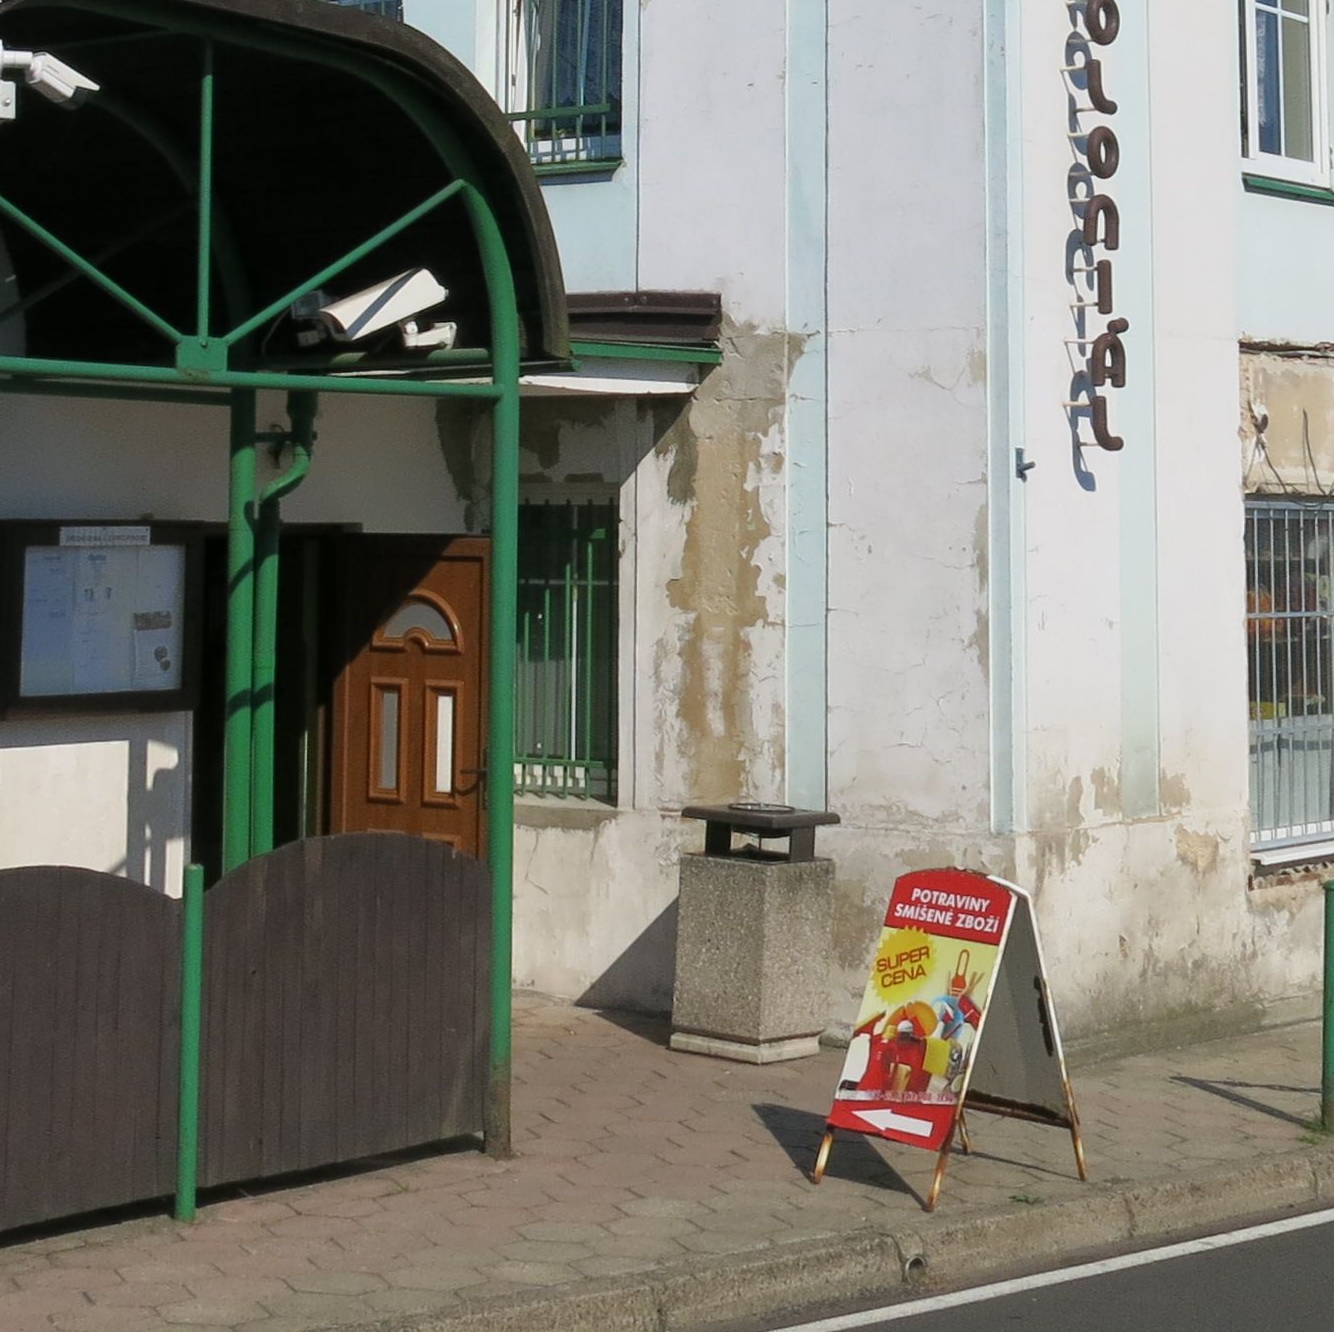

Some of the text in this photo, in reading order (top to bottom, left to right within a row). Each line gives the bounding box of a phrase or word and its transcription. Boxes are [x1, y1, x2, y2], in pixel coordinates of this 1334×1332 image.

[911, 887, 990, 912] POTRAVINY
[894, 903, 999, 933] SMÍŠENÉ ZBOŽÍ
[876, 945, 930, 972] SUPER
[881, 964, 927, 988] CENA
